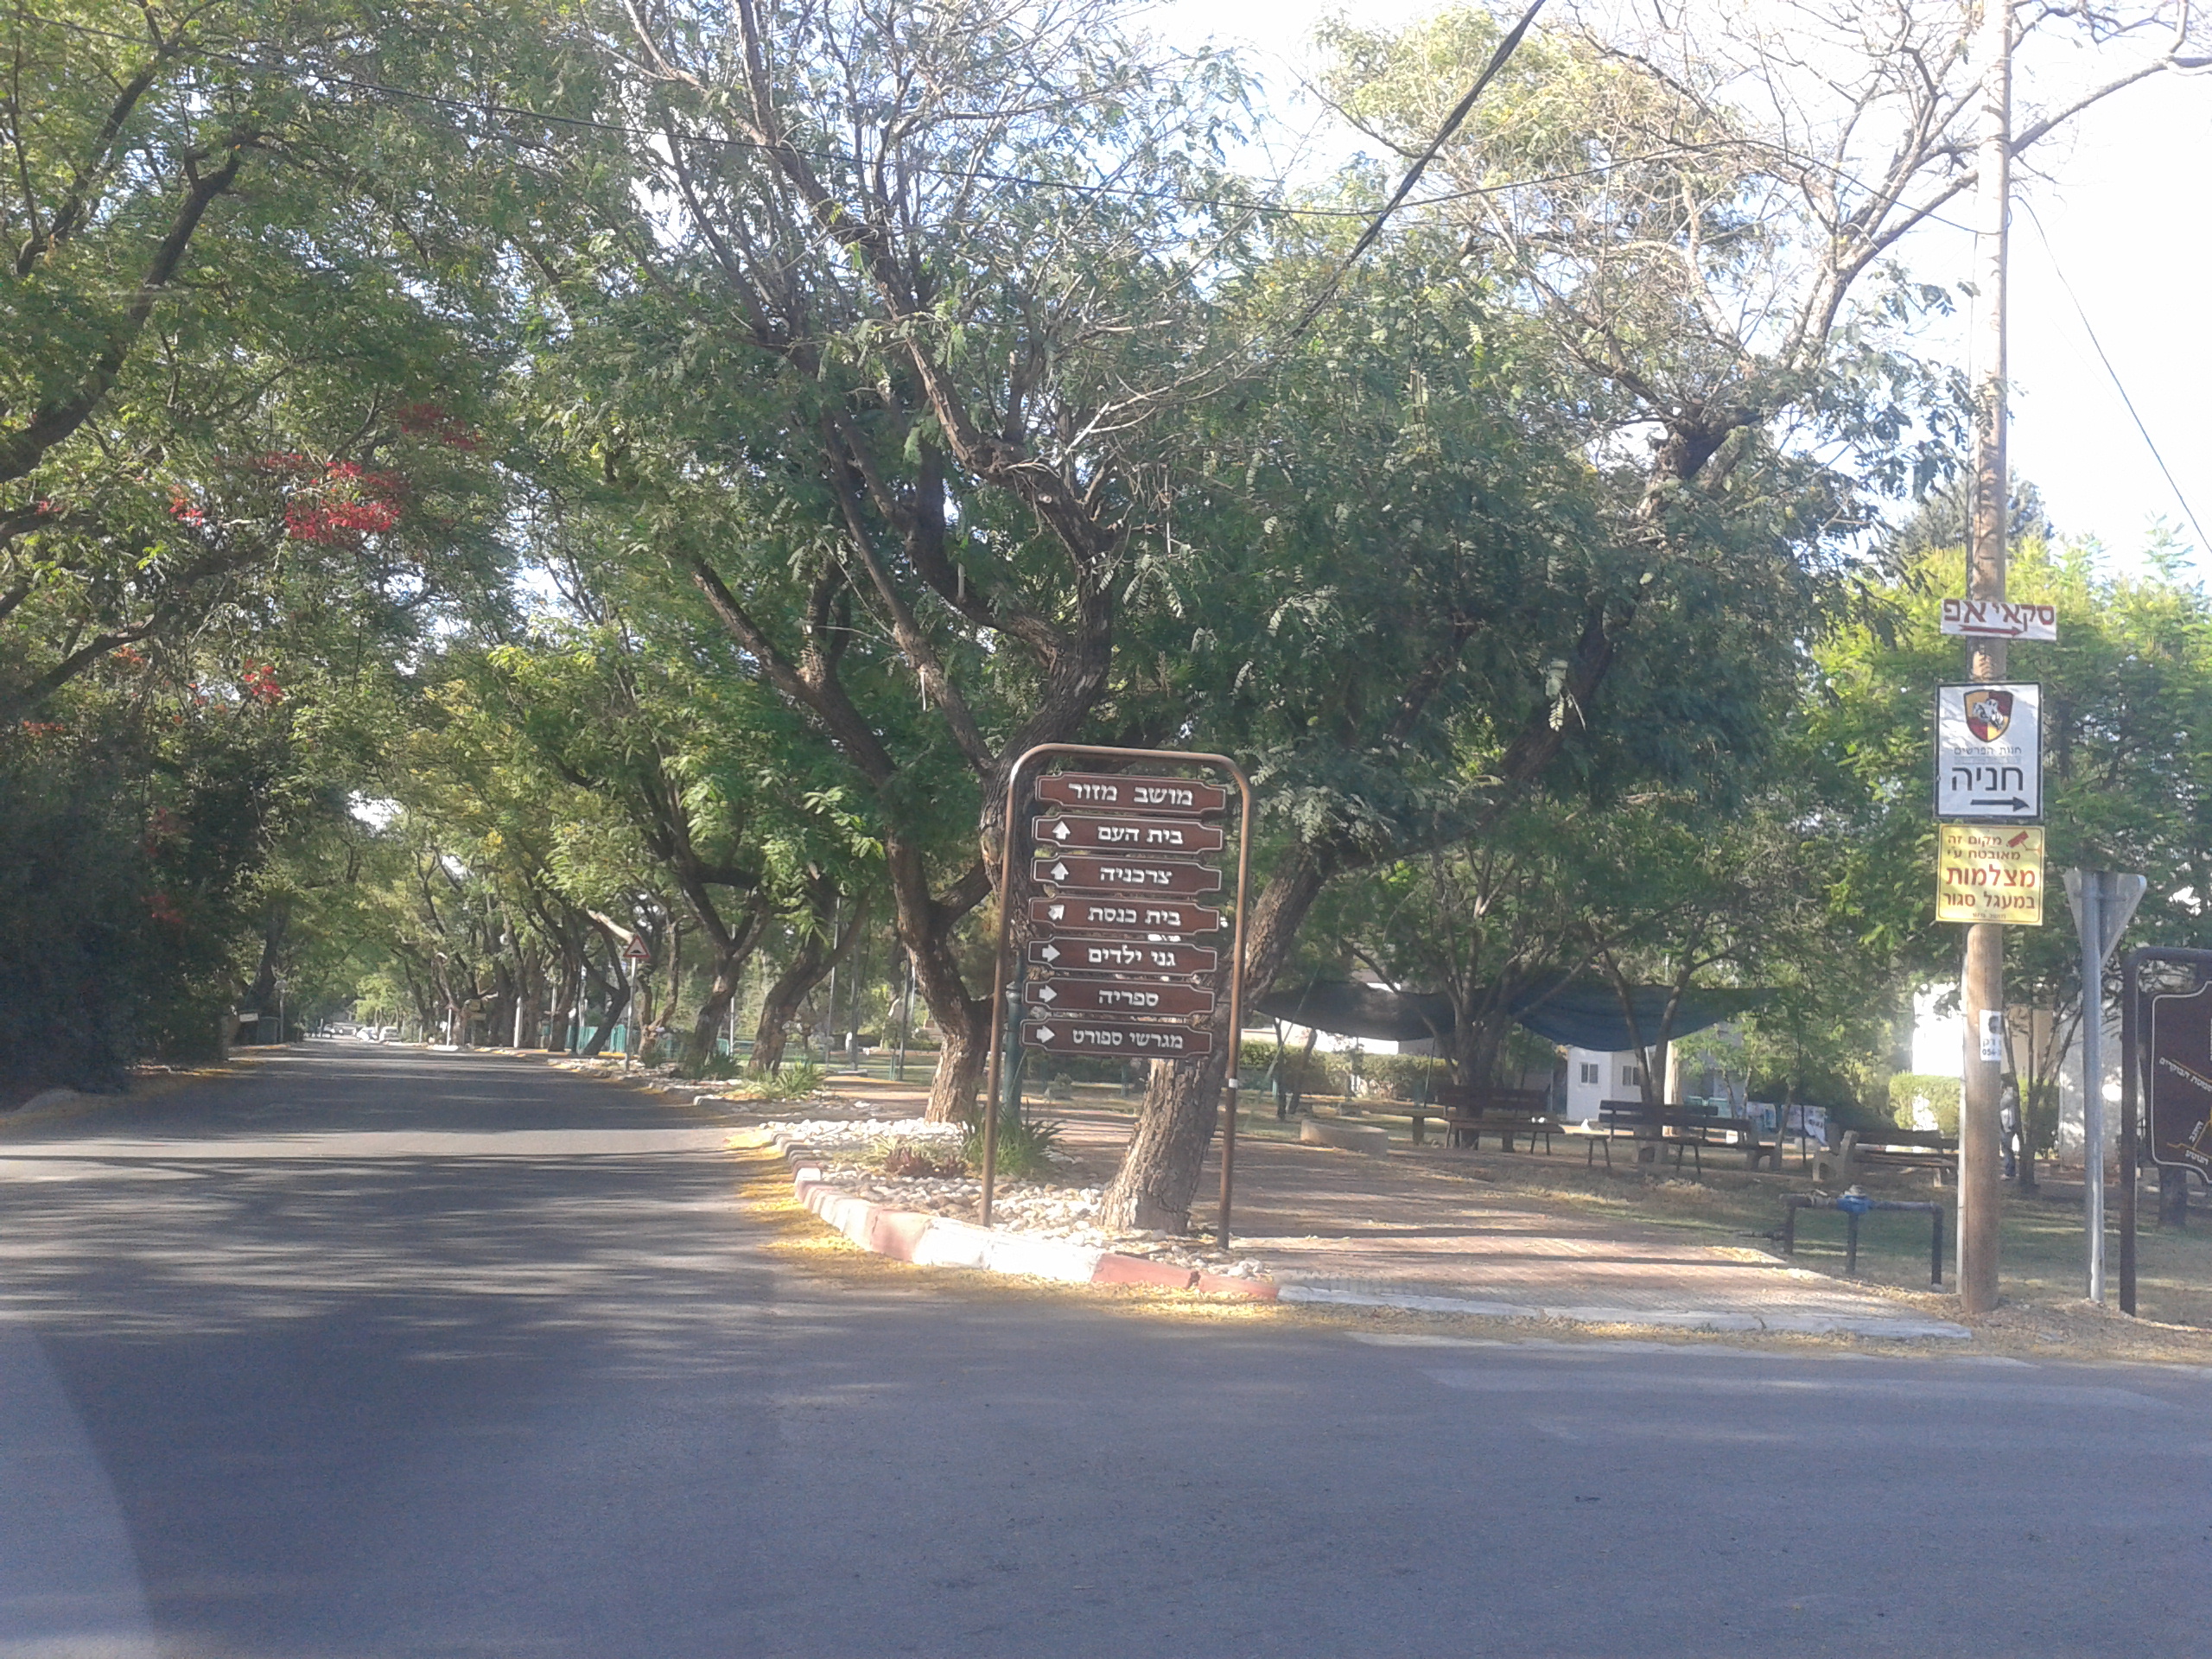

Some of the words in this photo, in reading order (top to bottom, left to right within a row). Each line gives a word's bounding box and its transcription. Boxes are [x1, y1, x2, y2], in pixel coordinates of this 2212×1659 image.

[1955, 747, 1993, 755] הפרשים
[1999, 747, 2022, 755] חוות
[1952, 767, 2023, 791] חניה
[1068, 784, 1117, 801] מזור
[1134, 785, 1192, 805] מושב
[1098, 826, 1139, 843] העם
[1147, 830, 1183, 844] בית
[1968, 836, 2002, 847] מקום
[1968, 850, 2020, 860] מאובטח
[1100, 867, 1173, 884] צרכניה
[1947, 864, 2035, 887] מצלמות
[1943, 893, 1975, 906] סגור
[1984, 891, 2035, 909] במעגל
[1087, 907, 1136, 924] כנסת
[1145, 912, 1180, 926] בית
[1088, 944, 1141, 964] ילדים
[1151, 951, 1176, 966] גני
[1099, 990, 1158, 1005] ספריה
[1073, 1030, 1122, 1046] ספורט
[1129, 1033, 1182, 1049] מגרשי
